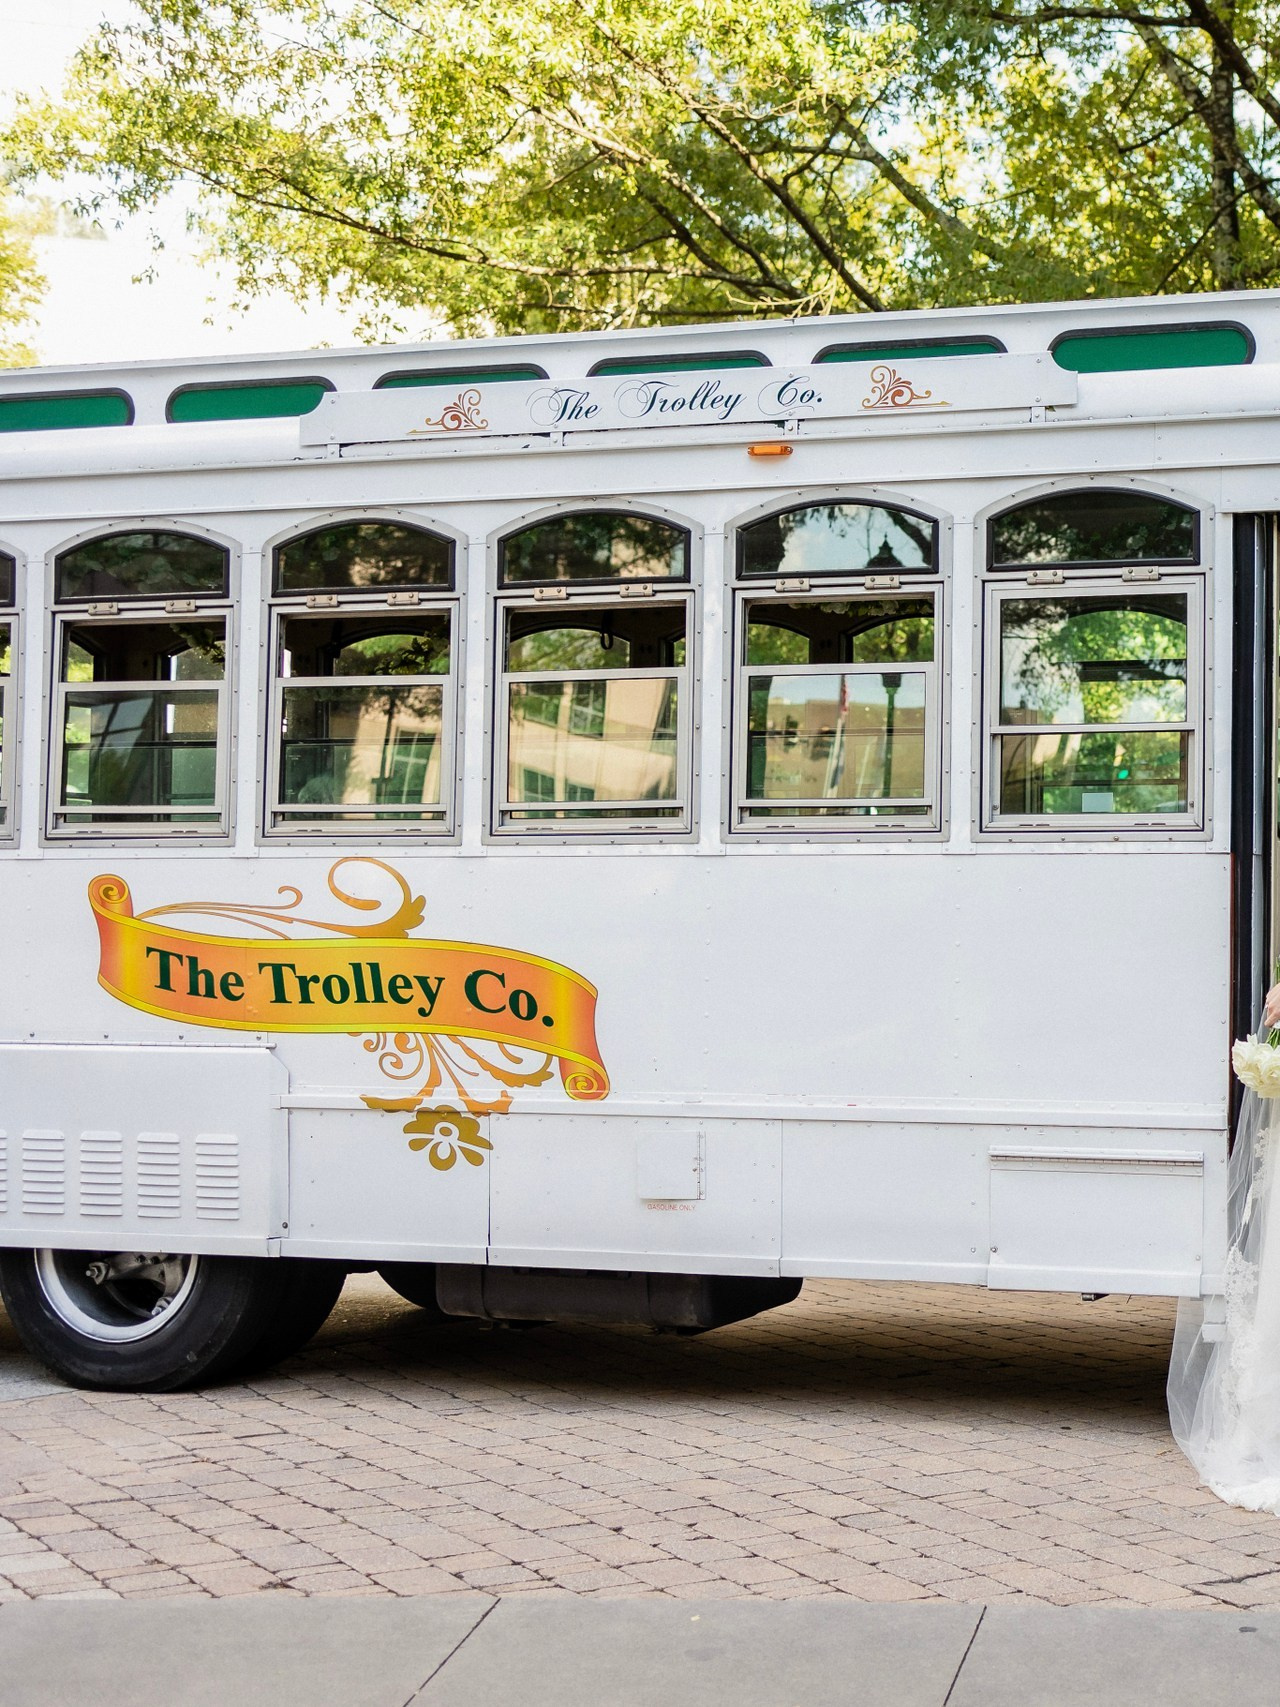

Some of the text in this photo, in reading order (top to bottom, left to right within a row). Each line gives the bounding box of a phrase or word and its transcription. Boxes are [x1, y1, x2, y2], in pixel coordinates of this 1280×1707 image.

[526, 376, 823, 426] The Trolley Co.
[146, 946, 555, 1027] The Trolley Co.
[647, 1203, 678, 1211] GASOLINE
